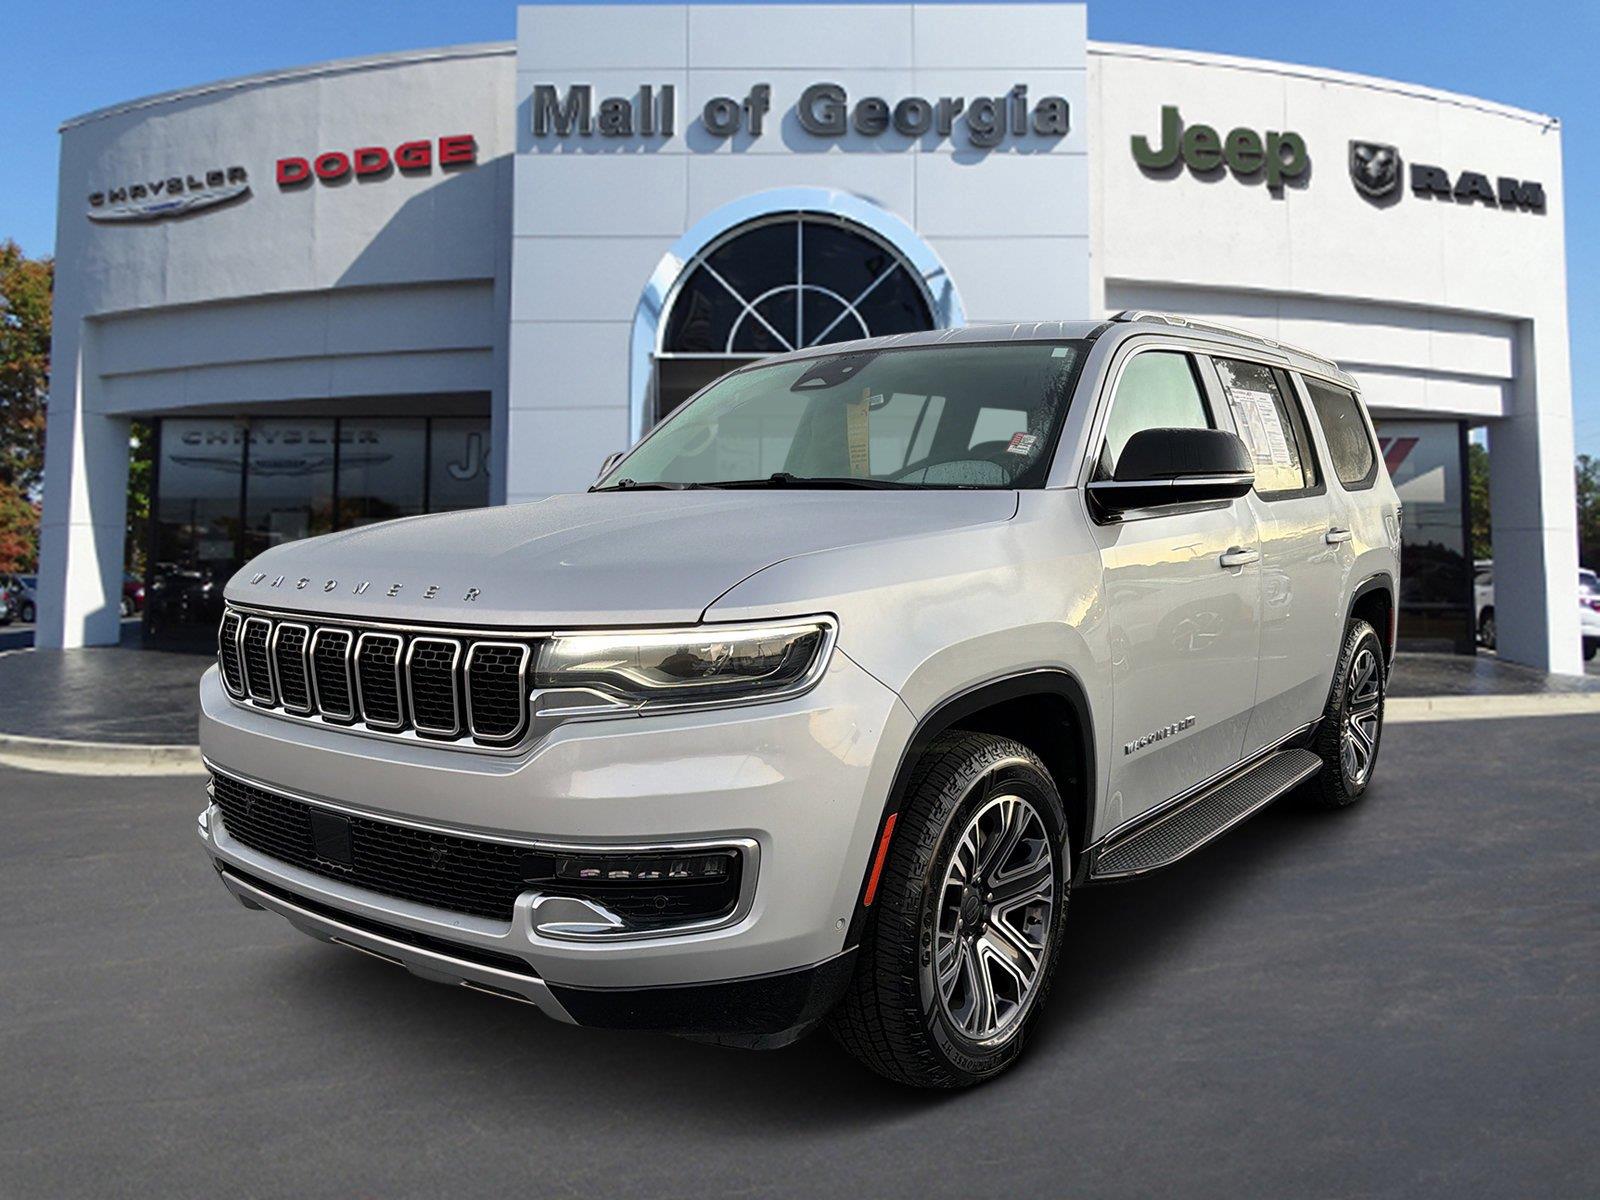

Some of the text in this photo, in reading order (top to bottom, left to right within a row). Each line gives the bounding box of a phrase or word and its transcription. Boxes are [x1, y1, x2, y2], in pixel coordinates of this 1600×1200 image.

[532, 83, 1072, 149] Mall of Georgia
[275, 134, 477, 190] DODGE
[1130, 105, 1309, 195] Jeep
[88, 165, 249, 208] CHRYSLER
[1409, 163, 1547, 213] RAM
[250, 572, 481, 602] WAGONEER
